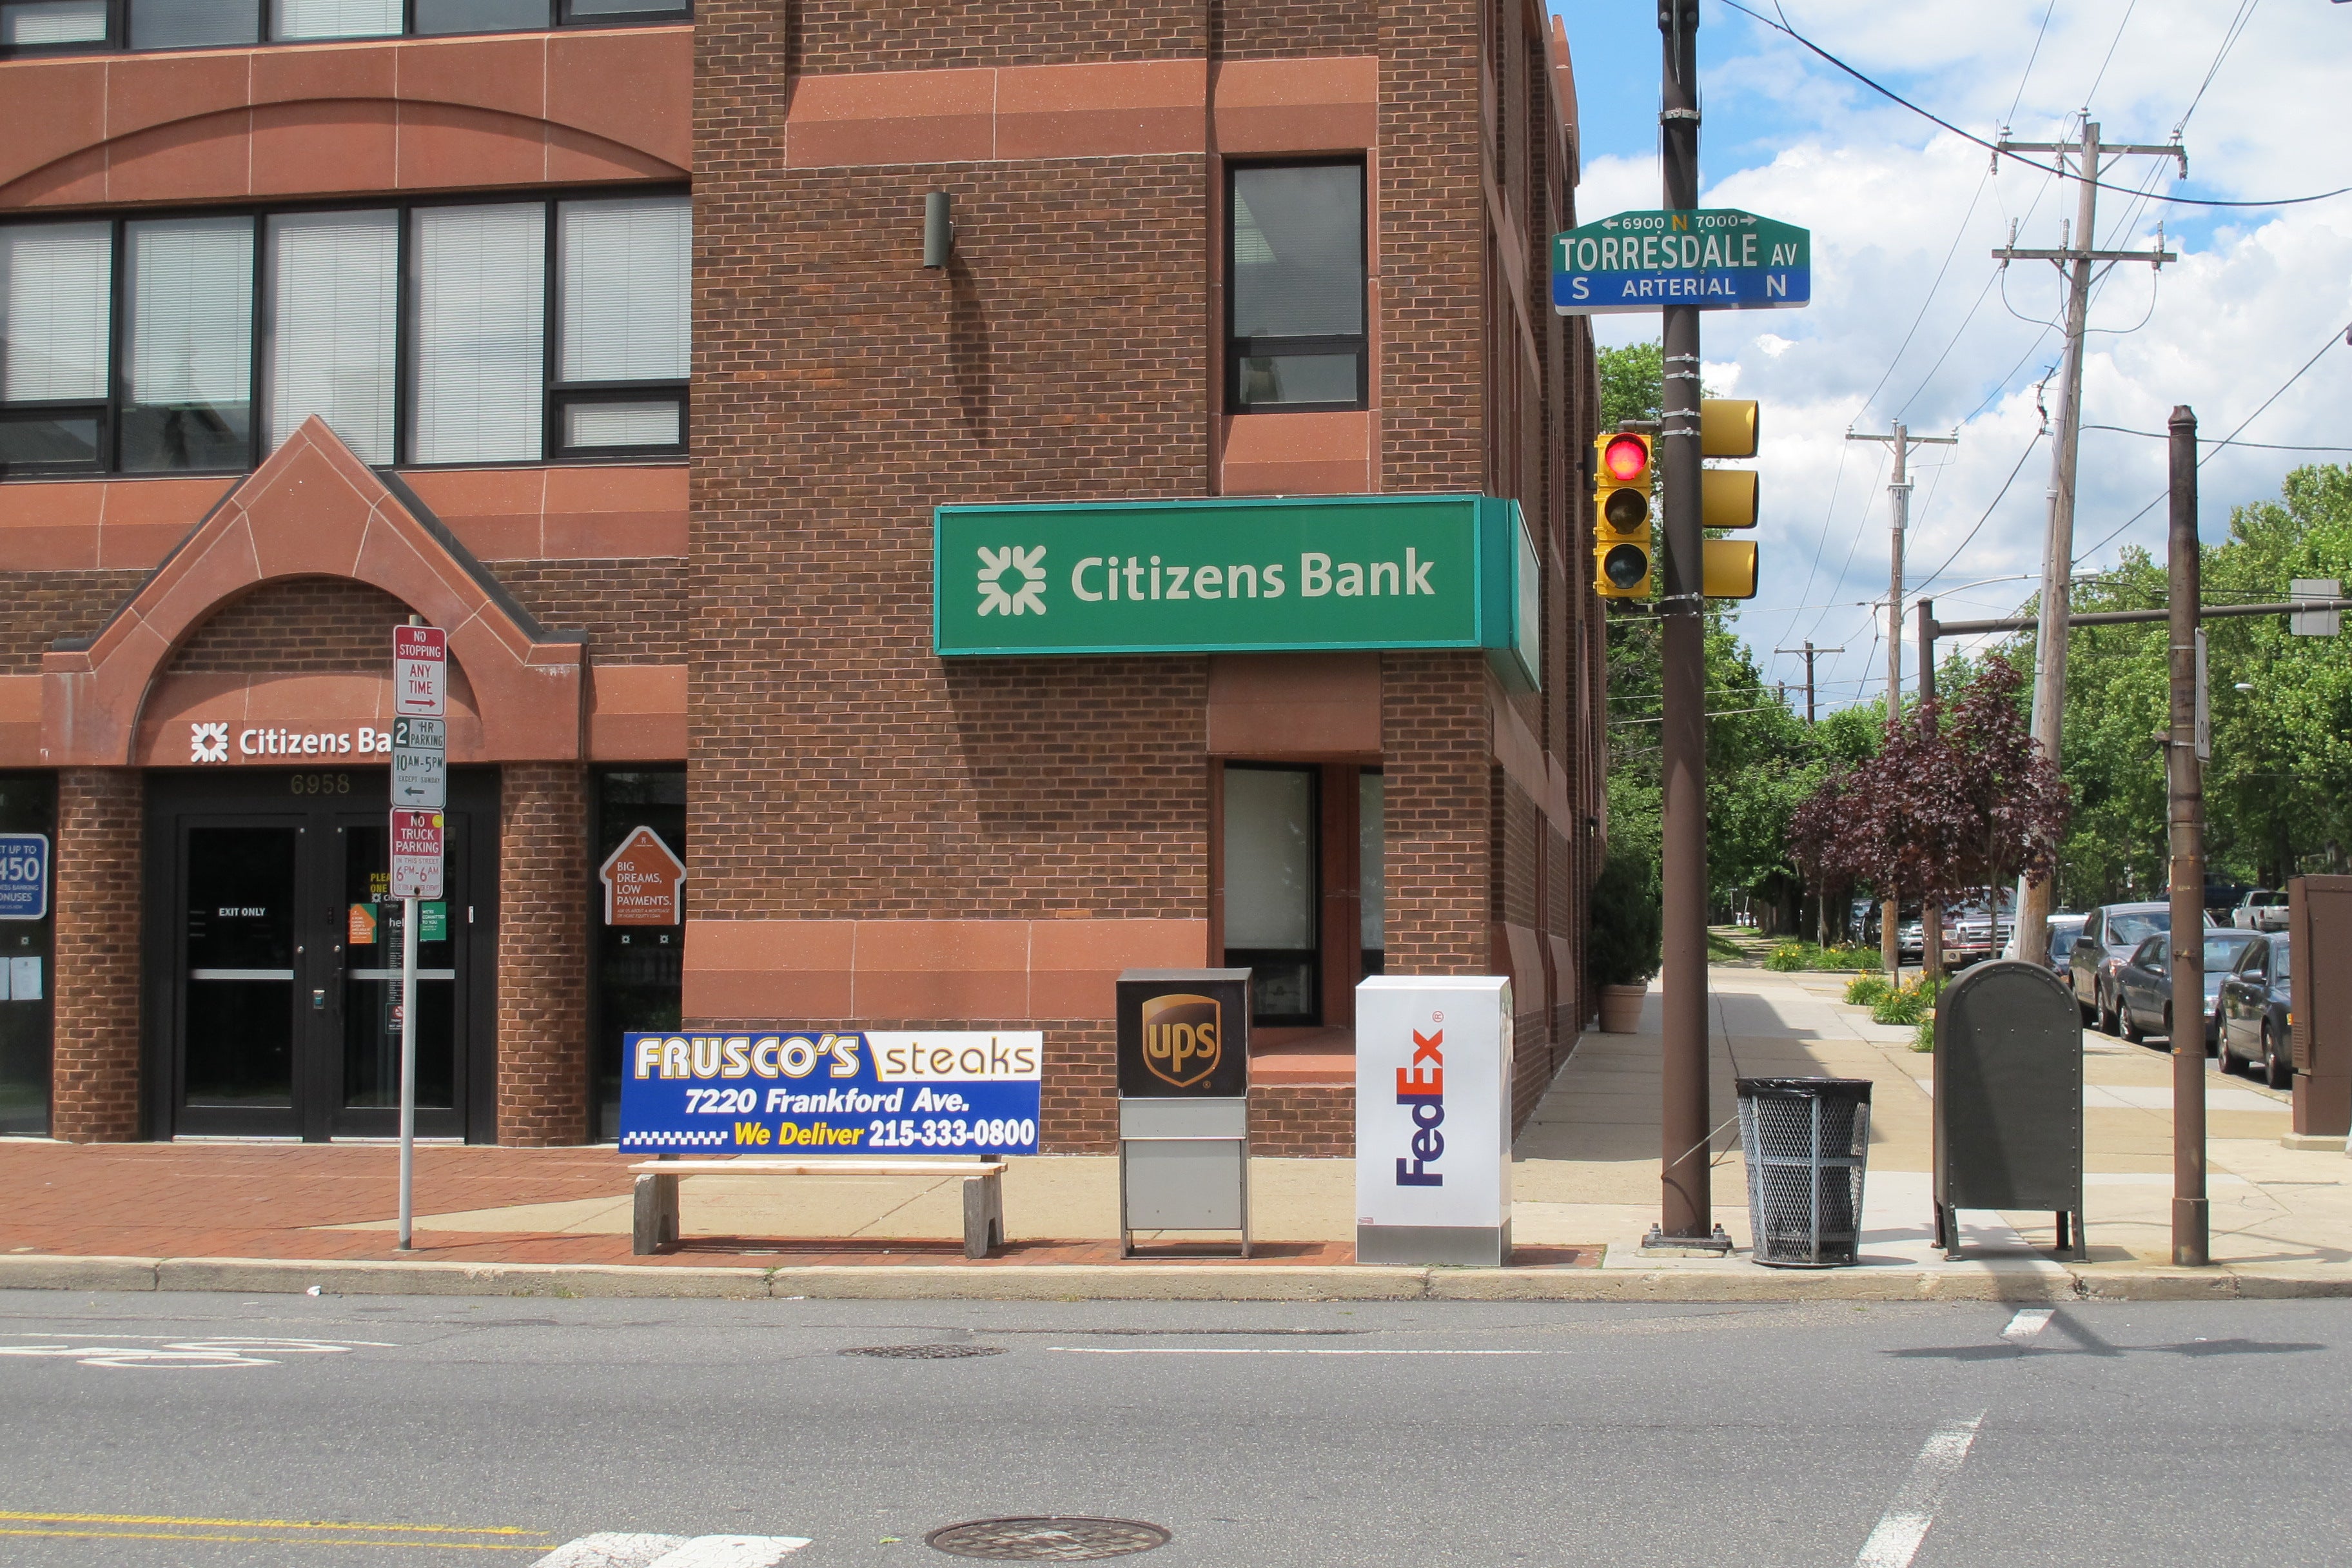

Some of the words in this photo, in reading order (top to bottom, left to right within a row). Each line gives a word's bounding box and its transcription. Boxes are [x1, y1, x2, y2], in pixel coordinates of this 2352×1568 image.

[1622, 217, 1664, 229] 6900
[1671, 215, 1687, 231] N
[1696, 215, 1738, 228] 7000
[1559, 234, 1758, 271] TORRESDALE
[1770, 243, 1797, 266] AV
[1572, 277, 1589, 300] S
[1622, 278, 1736, 297] ARTERIAL
[1766, 274, 1787, 297] N
[1070, 554, 1286, 602] Citizens
[1300, 547, 1435, 598] Bank
[414, 631, 426, 642] NO
[399, 643, 442, 658] STOPPING
[409, 663, 431, 678] ANY
[409, 680, 433, 694] TIME
[396, 722, 408, 745] 2
[420, 721, 434, 733] HR
[411, 733, 444, 747] PARKING
[239, 728, 351, 754] Citizens
[358, 727, 392, 753] Ba
[291, 774, 351, 794] 6958
[410, 815, 426, 827] NO
[400, 828, 435, 841] TRUCK
[9, 845, 21, 854] UP
[24, 845, 37, 854] TO
[395, 841, 439, 854] PARKING
[617, 862, 634, 871] BIG
[370, 873, 391, 882] PLEA
[617, 873, 662, 884] DREAMS,
[370, 884, 387, 893] ONE
[617, 885, 642, 894] LOW
[617, 896, 672, 906] PAYMENTS.
[219, 908, 239, 916] EXIT
[241, 908, 266, 916] ONLY
[1148, 1022, 1215, 1072] ups
[634, 1034, 860, 1080] FRUSCO'S
[885, 1037, 1035, 1076] steaks
[685, 1088, 757, 1114] 7220
[765, 1087, 904, 1114] Frankford
[911, 1087, 970, 1113] Ave.
[1396, 1028, 1445, 1186] FedEx
[734, 1122, 770, 1145] We
[779, 1121, 865, 1146] Deliver
[868, 1119, 1035, 1147] 215-333-0800
